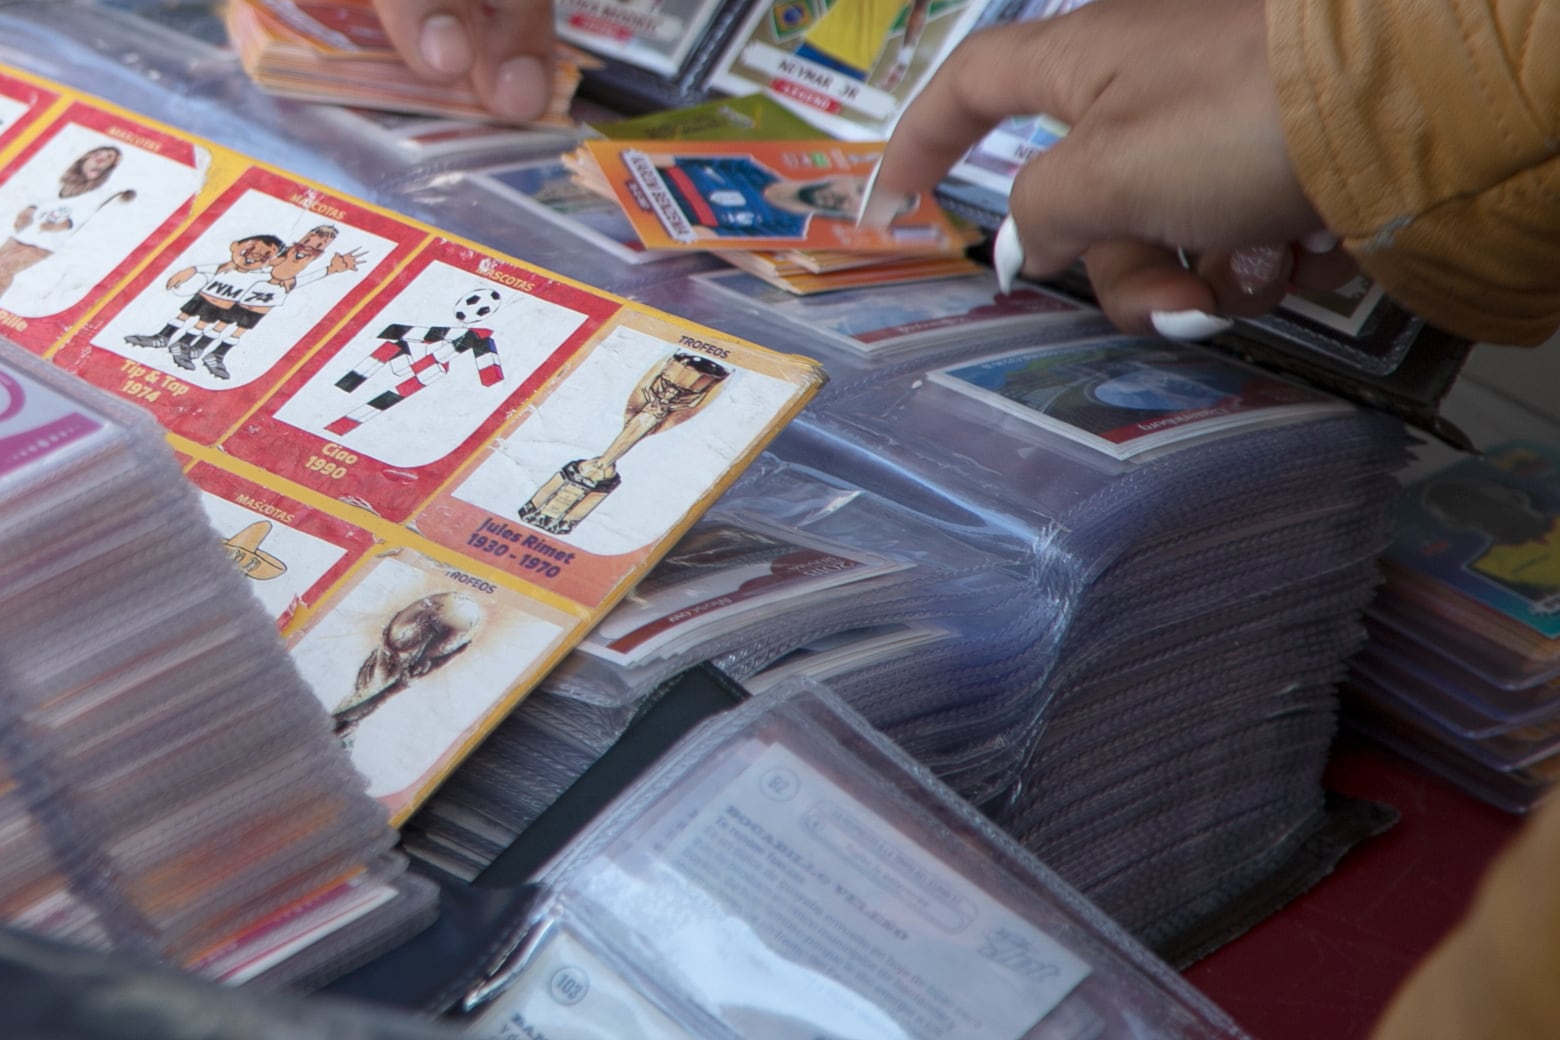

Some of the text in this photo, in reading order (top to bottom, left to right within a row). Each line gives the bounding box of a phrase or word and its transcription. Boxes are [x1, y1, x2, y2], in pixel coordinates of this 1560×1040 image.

[779, 59, 861, 102] NEYMAR JR
[206, 280, 244, 300] WM
[244, 290, 276, 304] 74
[678, 335, 732, 360] TROFEOS
[119, 359, 191, 398] Tip & Tap
[120, 379, 161, 403] 1974
[321, 442, 358, 465] Ciao
[304, 454, 348, 481] 1990
[235, 493, 295, 525] MASCOTAS
[478, 517, 576, 565] Jules Rimet
[466, 531, 507, 559] 1930
[518, 553, 562, 580] 1970
[557, 974, 583, 1000] 103
